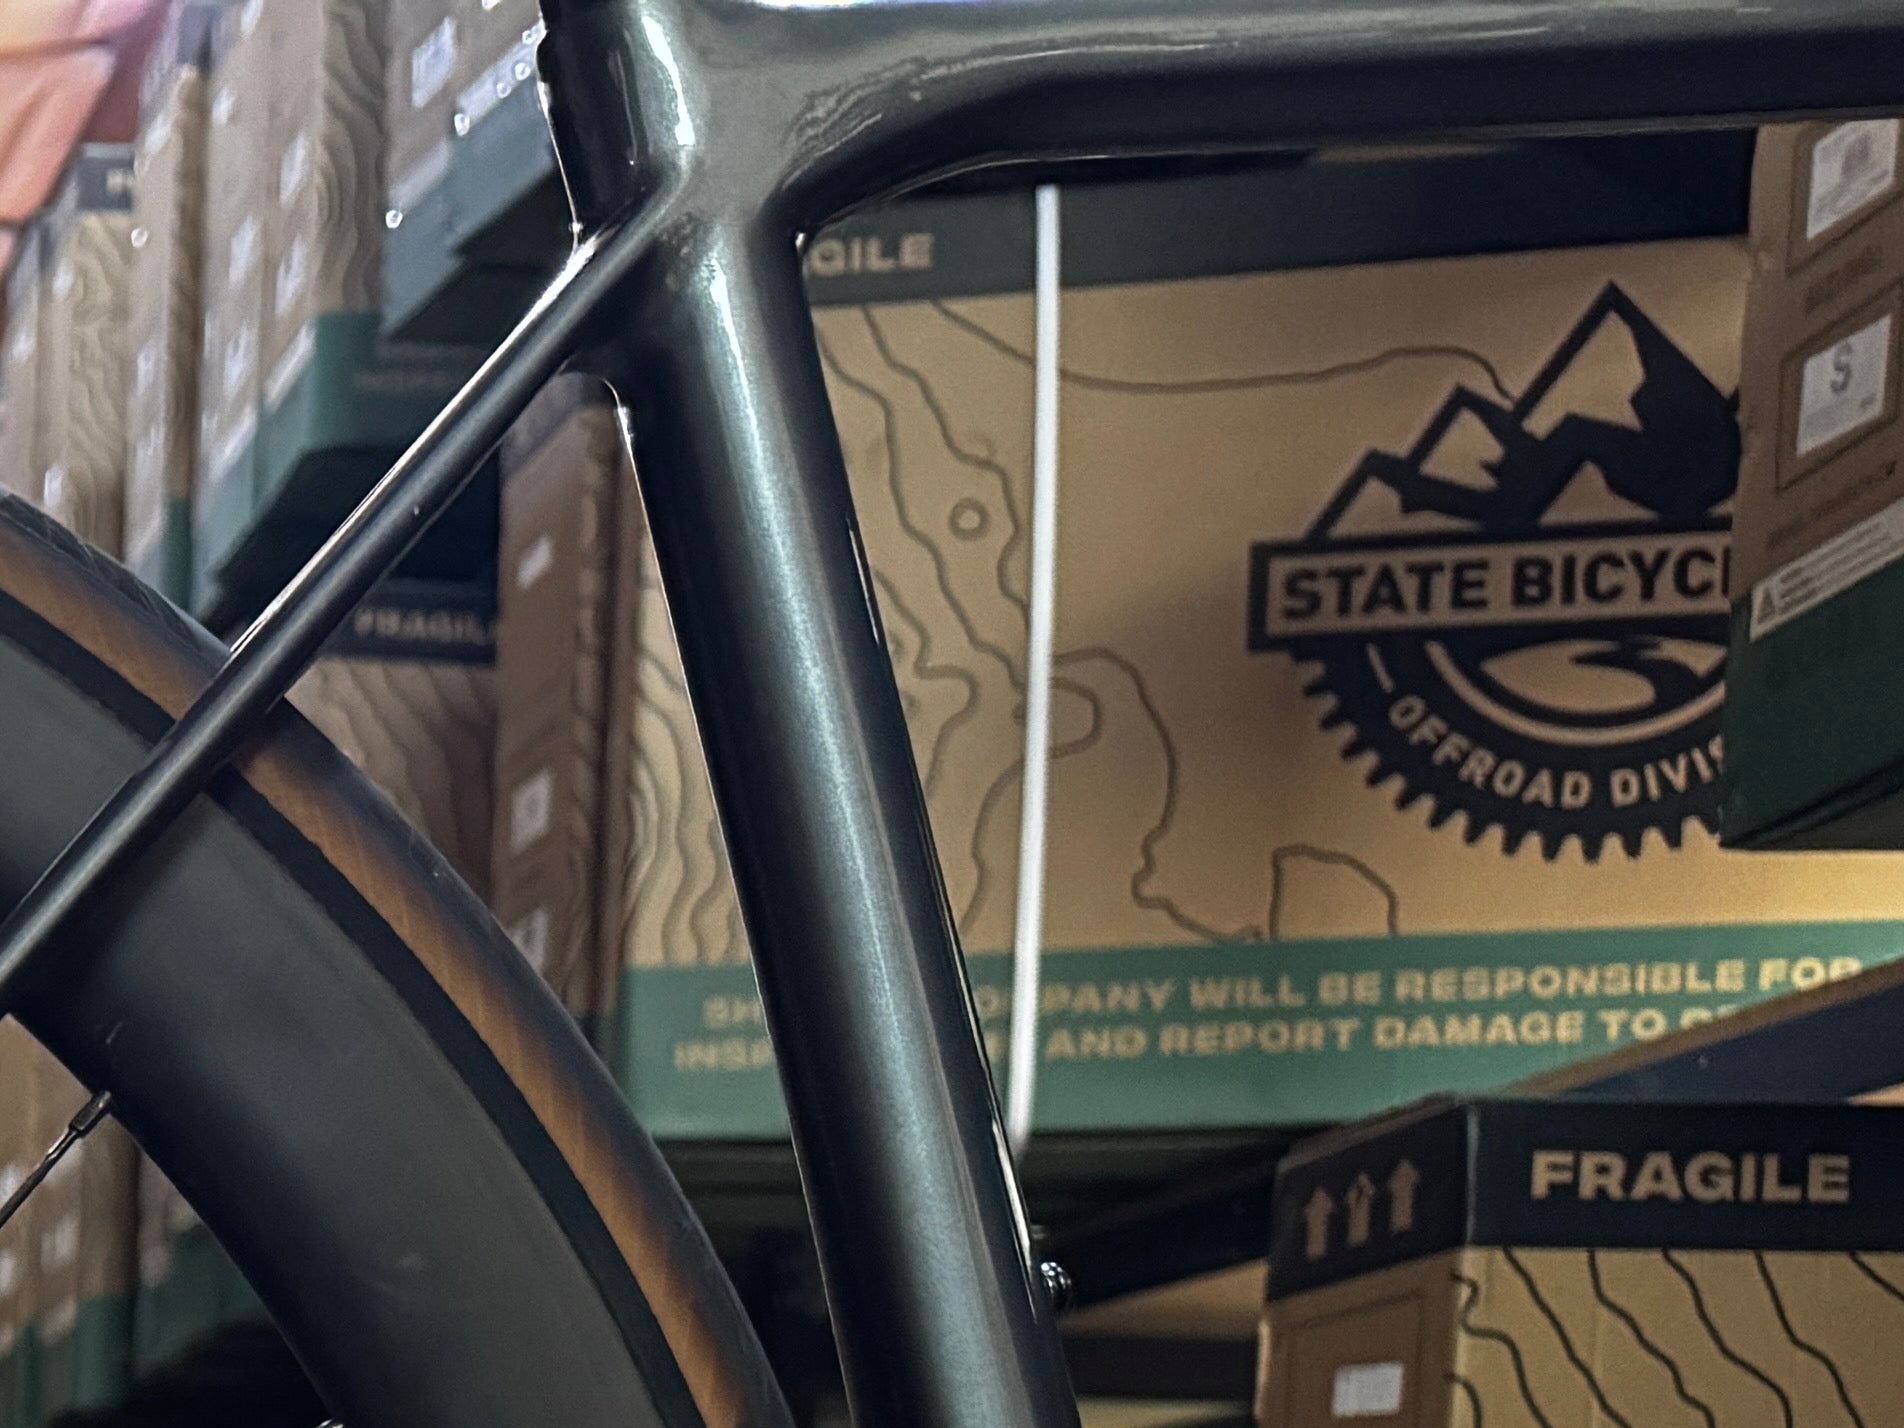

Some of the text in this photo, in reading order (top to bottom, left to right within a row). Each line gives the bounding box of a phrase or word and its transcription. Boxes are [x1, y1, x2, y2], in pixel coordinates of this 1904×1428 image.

[808, 232, 936, 278] GILE
[1283, 560, 1490, 620] STATE
[1389, 694, 1592, 810] OFFROAD
[1189, 973, 1304, 1010] WILL
[1319, 970, 1382, 1006] BE
[1396, 959, 1745, 1002] RESPONSIBLE
[1759, 955, 1863, 993] FOR
[1045, 1026, 1148, 1061] AND
[1160, 1016, 1360, 1058] REPORT
[1376, 1010, 1585, 1051] DAMAGE
[1599, 1007, 1669, 1042] TO
[1530, 1149, 1850, 1203] FRAGILE
